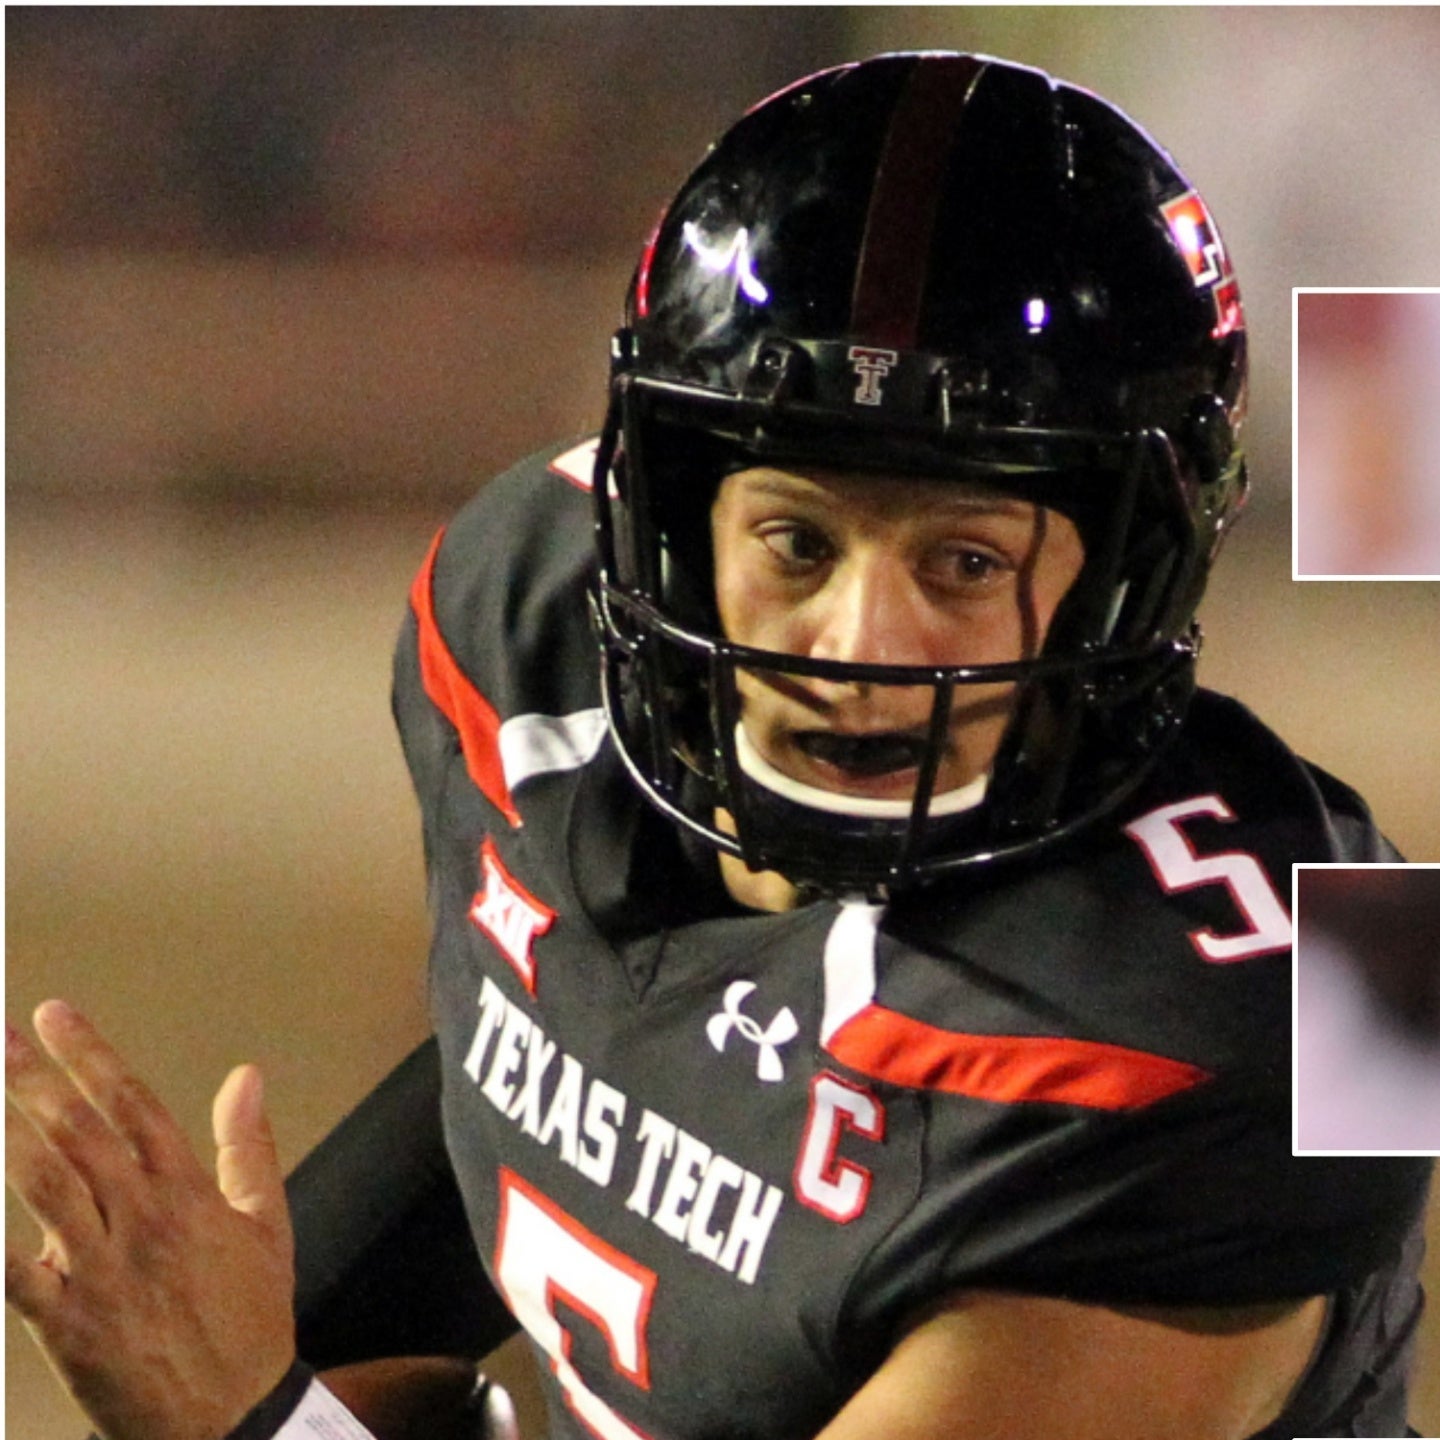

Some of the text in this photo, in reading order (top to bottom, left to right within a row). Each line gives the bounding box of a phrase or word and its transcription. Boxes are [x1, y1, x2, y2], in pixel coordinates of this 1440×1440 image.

[1123, 795, 1293, 963] 5
[463, 977, 784, 1285] TEXAS TECH
[792, 1068, 884, 1225] C
